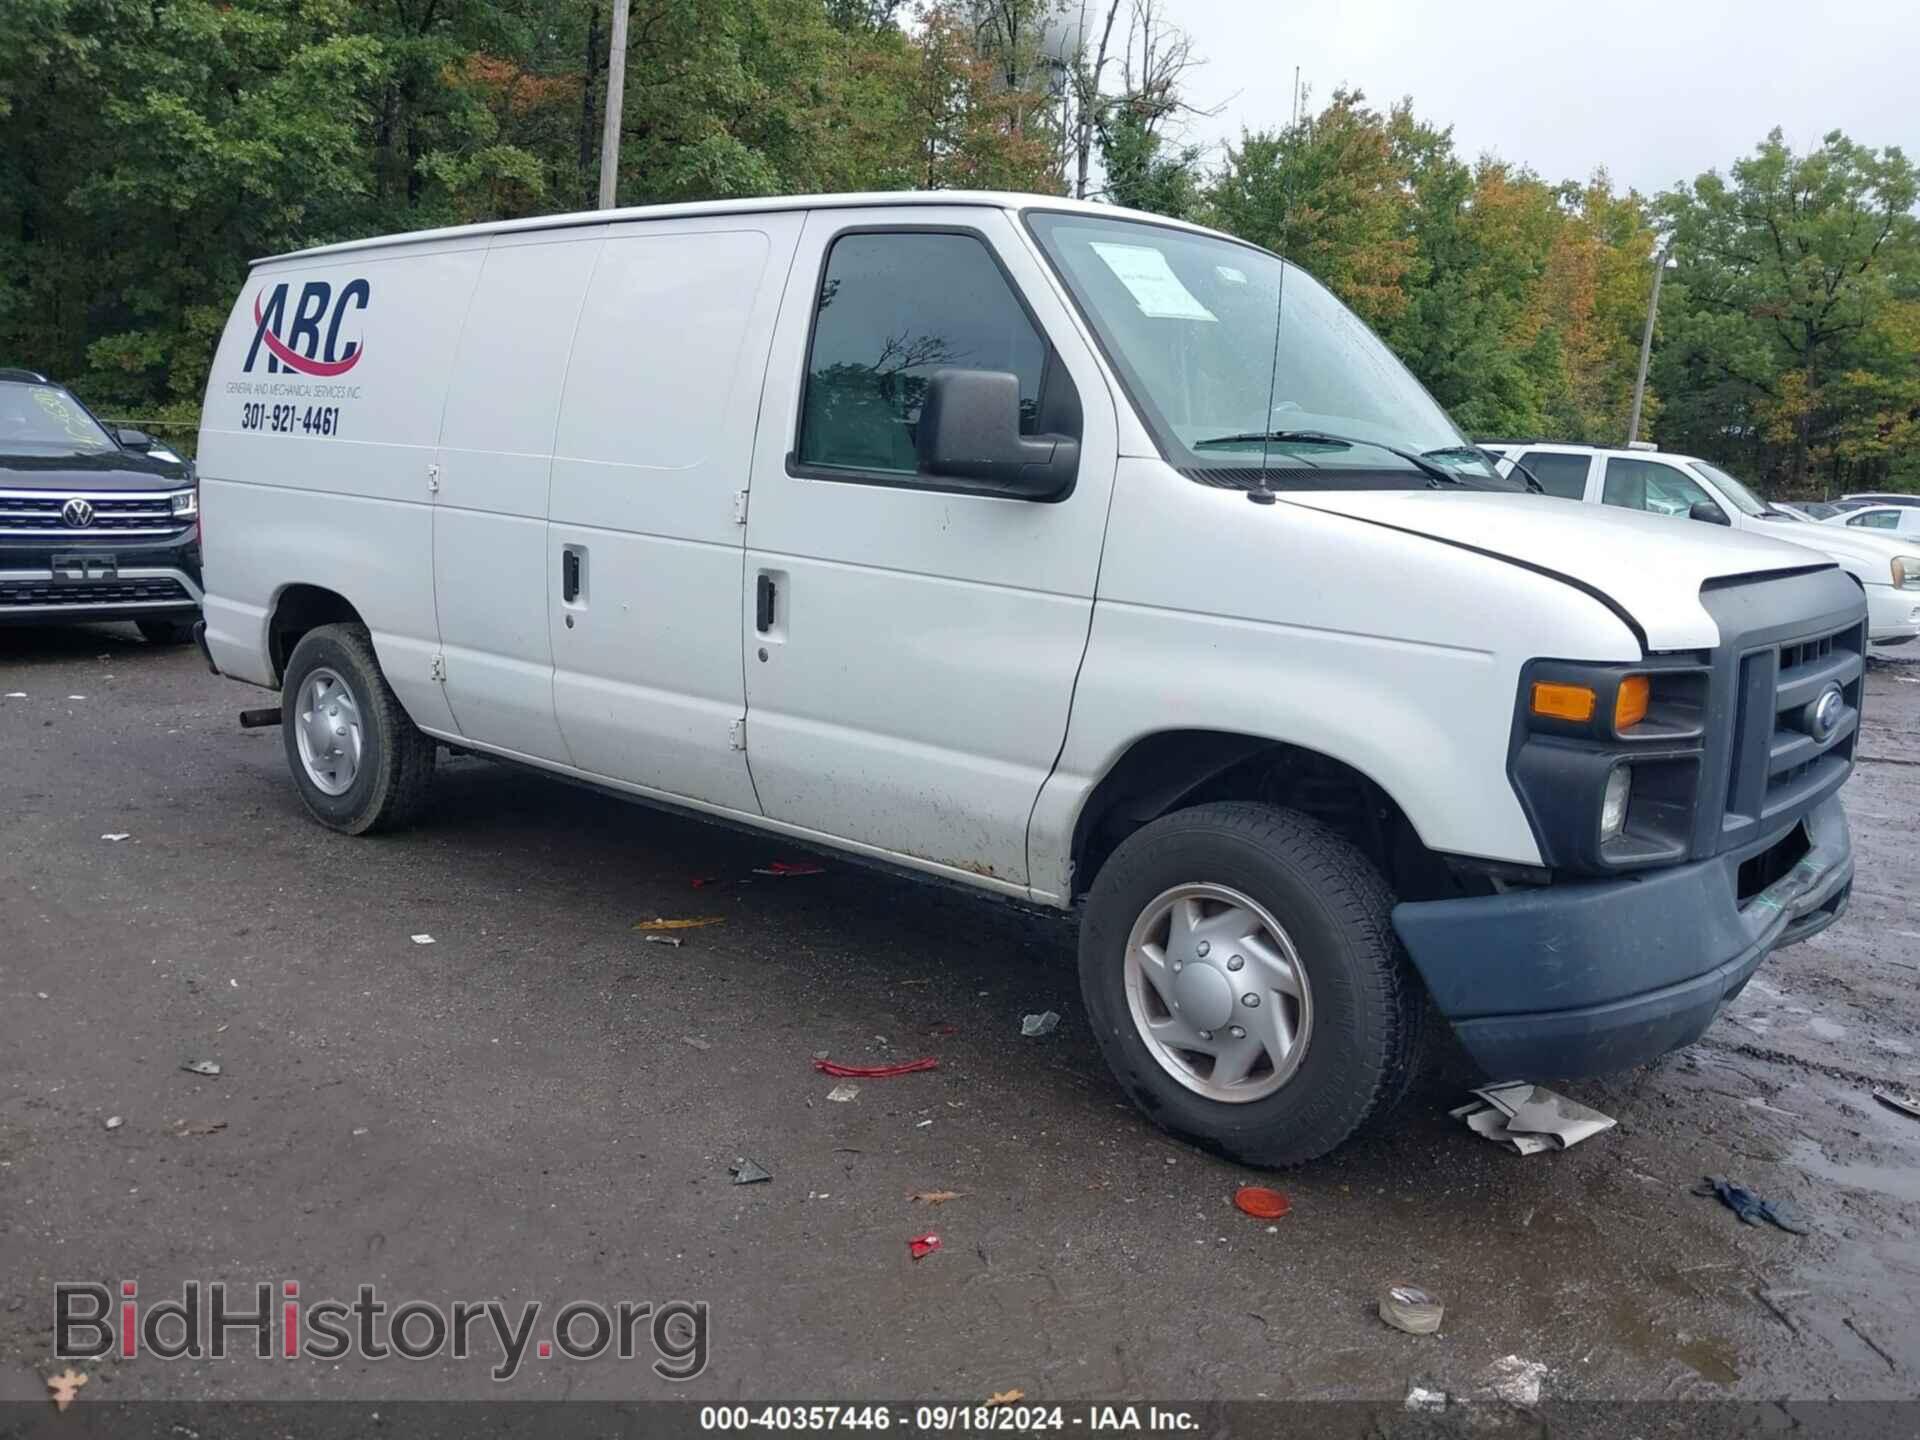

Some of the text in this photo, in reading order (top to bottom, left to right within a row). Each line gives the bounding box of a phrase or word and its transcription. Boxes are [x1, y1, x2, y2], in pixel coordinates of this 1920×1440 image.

[243, 278, 370, 374] ABC
[253, 383, 268, 395] AND
[269, 383, 313, 398] MECHANICAL
[313, 384, 346, 399] SERVICES
[241, 402, 339, 436] 301-921-4461
